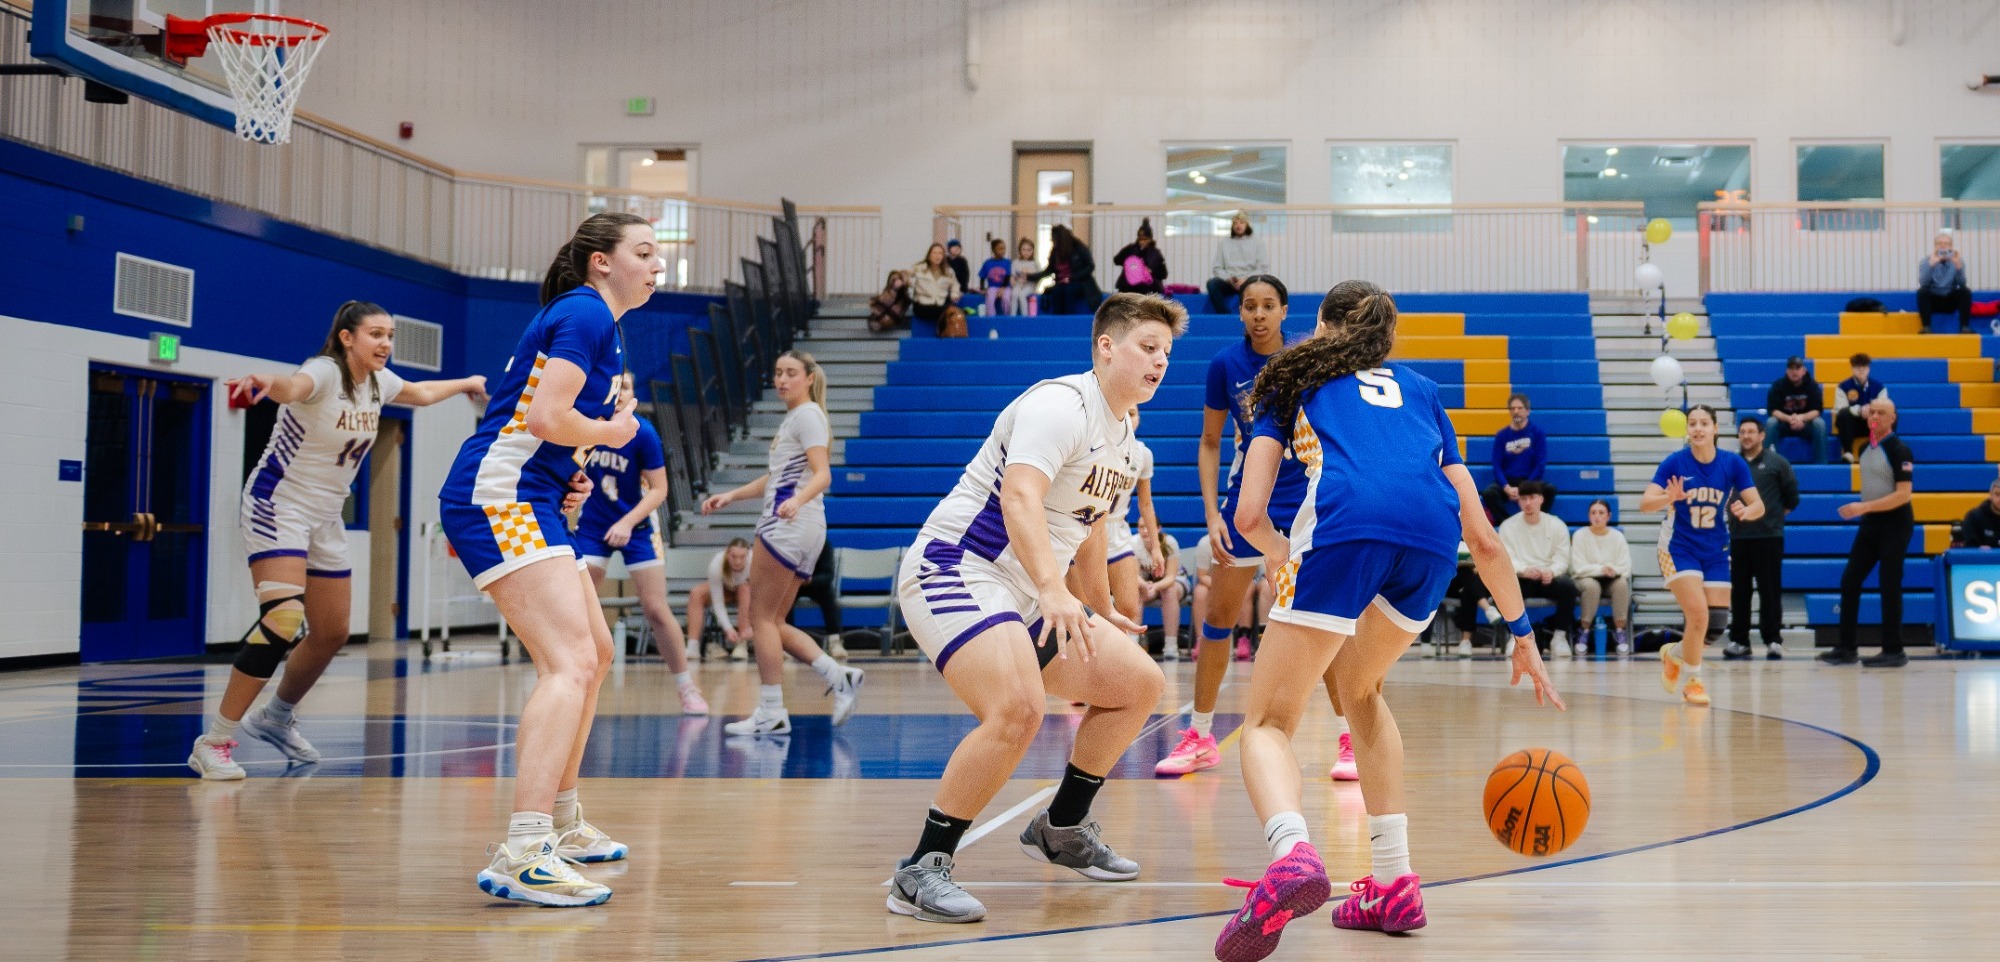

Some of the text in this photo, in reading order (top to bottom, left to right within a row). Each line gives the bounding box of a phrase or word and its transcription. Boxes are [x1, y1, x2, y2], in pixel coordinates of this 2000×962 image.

[1354, 368, 1404, 409] 5
[336, 410, 380, 432] ALFRE
[335, 438, 372, 469] 14
[590, 450, 629, 474] POLY
[1686, 486, 1725, 505] POLY
[1689, 505, 1717, 529] 12
[1963, 580, 2000, 624] S
